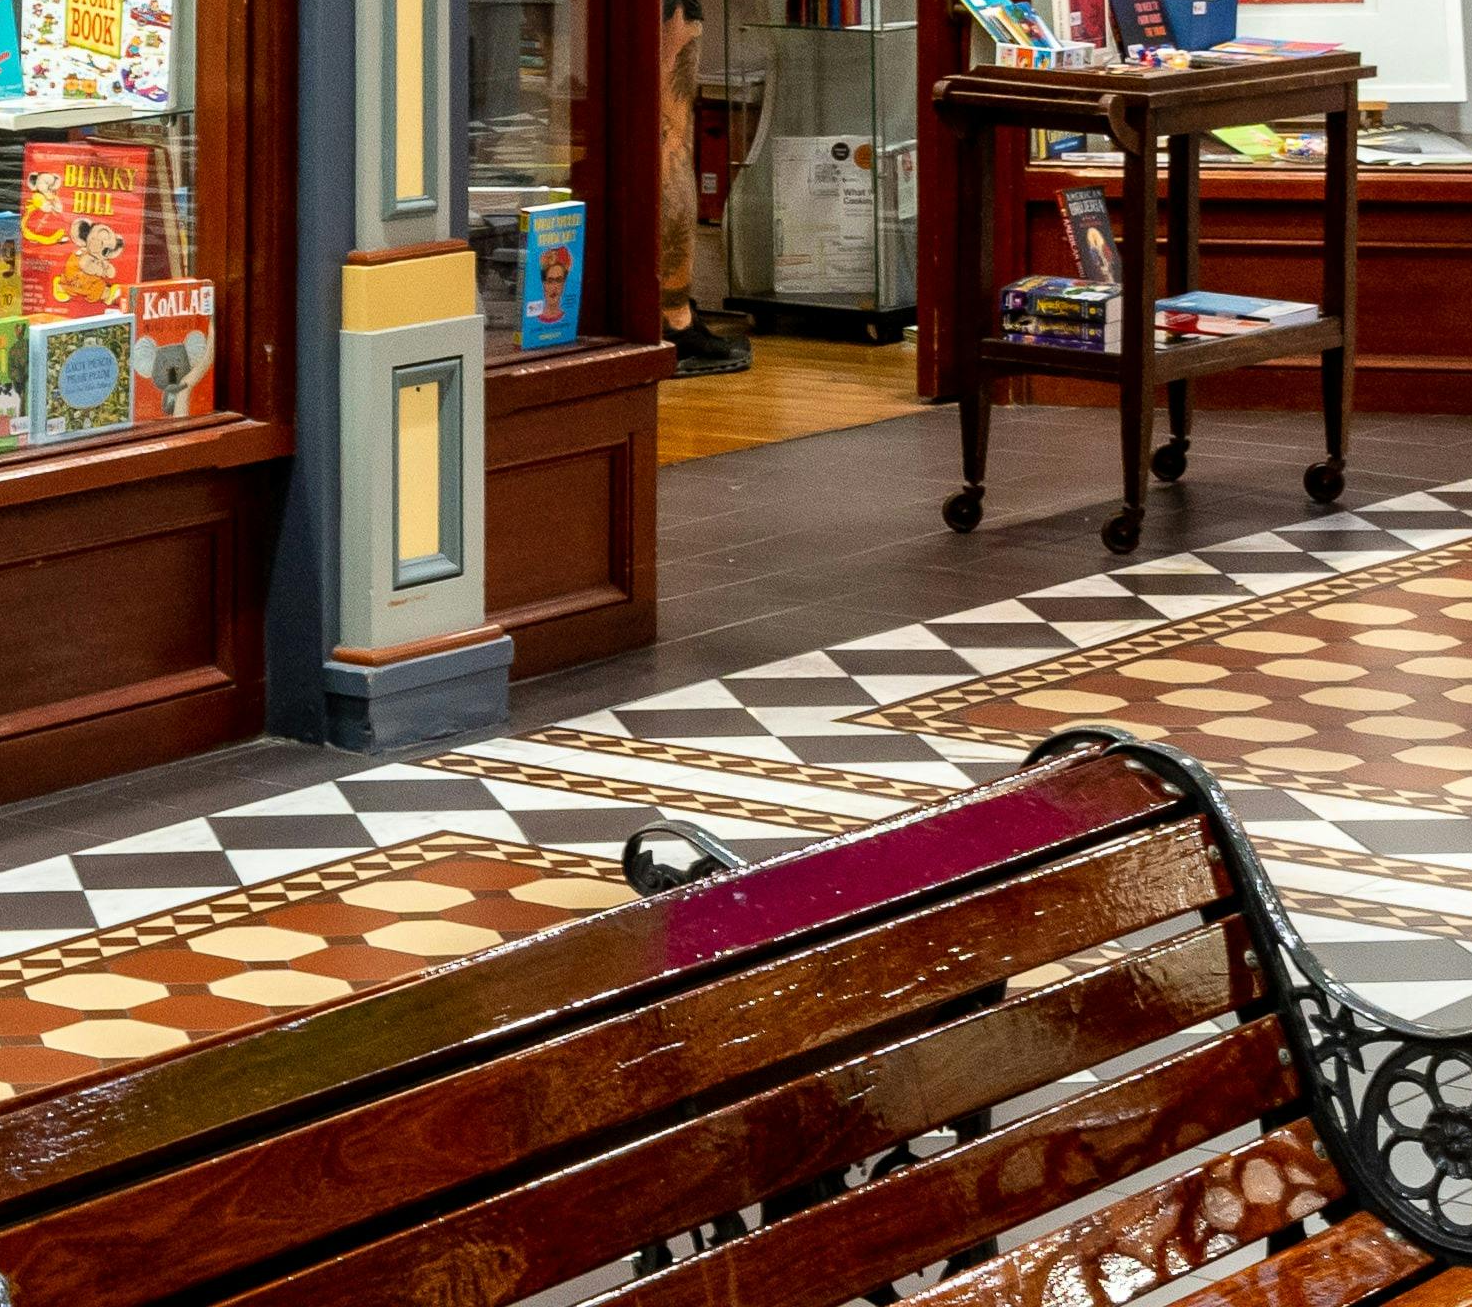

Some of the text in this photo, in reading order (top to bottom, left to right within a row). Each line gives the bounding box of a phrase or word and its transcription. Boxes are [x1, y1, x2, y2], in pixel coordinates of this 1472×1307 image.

[70, 7, 115, 47] BOOK
[64, 163, 139, 192] BLINKY
[72, 190, 115, 216] BILL
